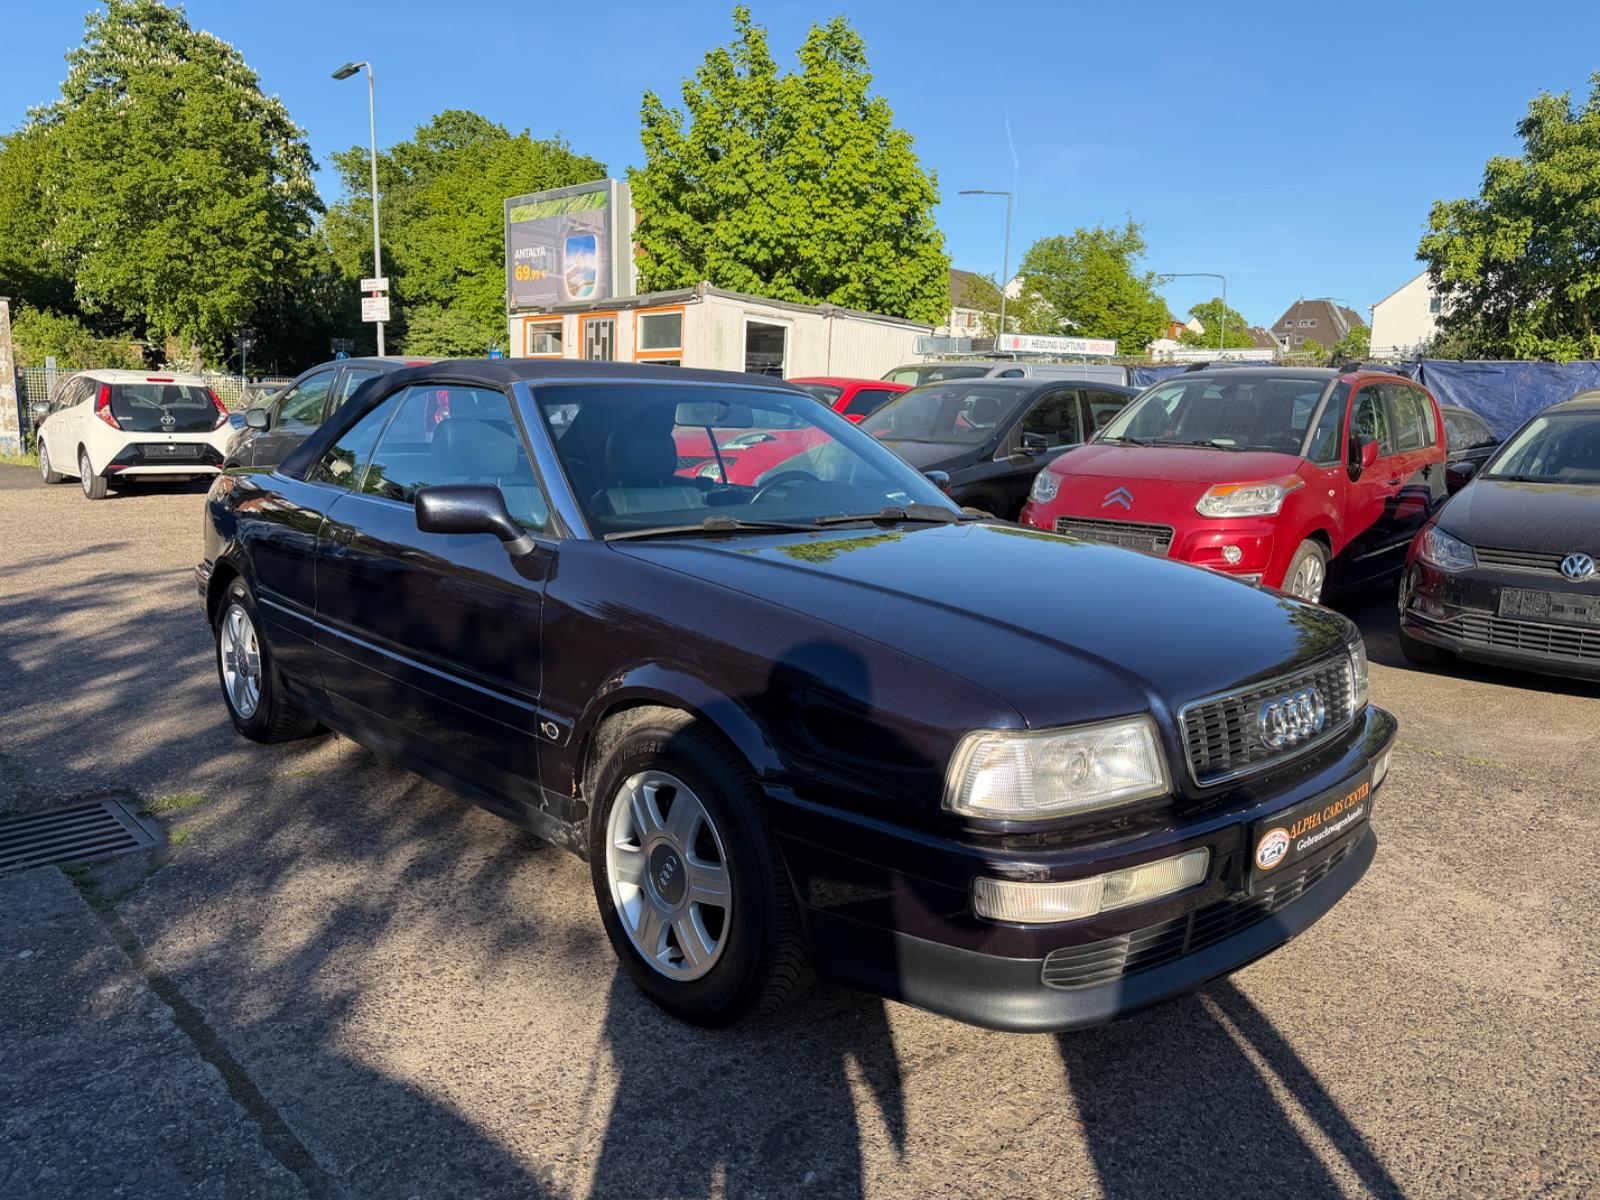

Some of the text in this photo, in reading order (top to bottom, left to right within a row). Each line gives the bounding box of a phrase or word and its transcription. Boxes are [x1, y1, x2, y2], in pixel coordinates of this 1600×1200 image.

[514, 246, 546, 259] ANTALYA
[1031, 339, 1059, 350] HEIZUNG
[1060, 340, 1087, 351] LÜFTUNG
[1290, 782, 1369, 839] ALPHA CARS CENTER
[1296, 804, 1364, 851] Gebrauchtwagenhandel
